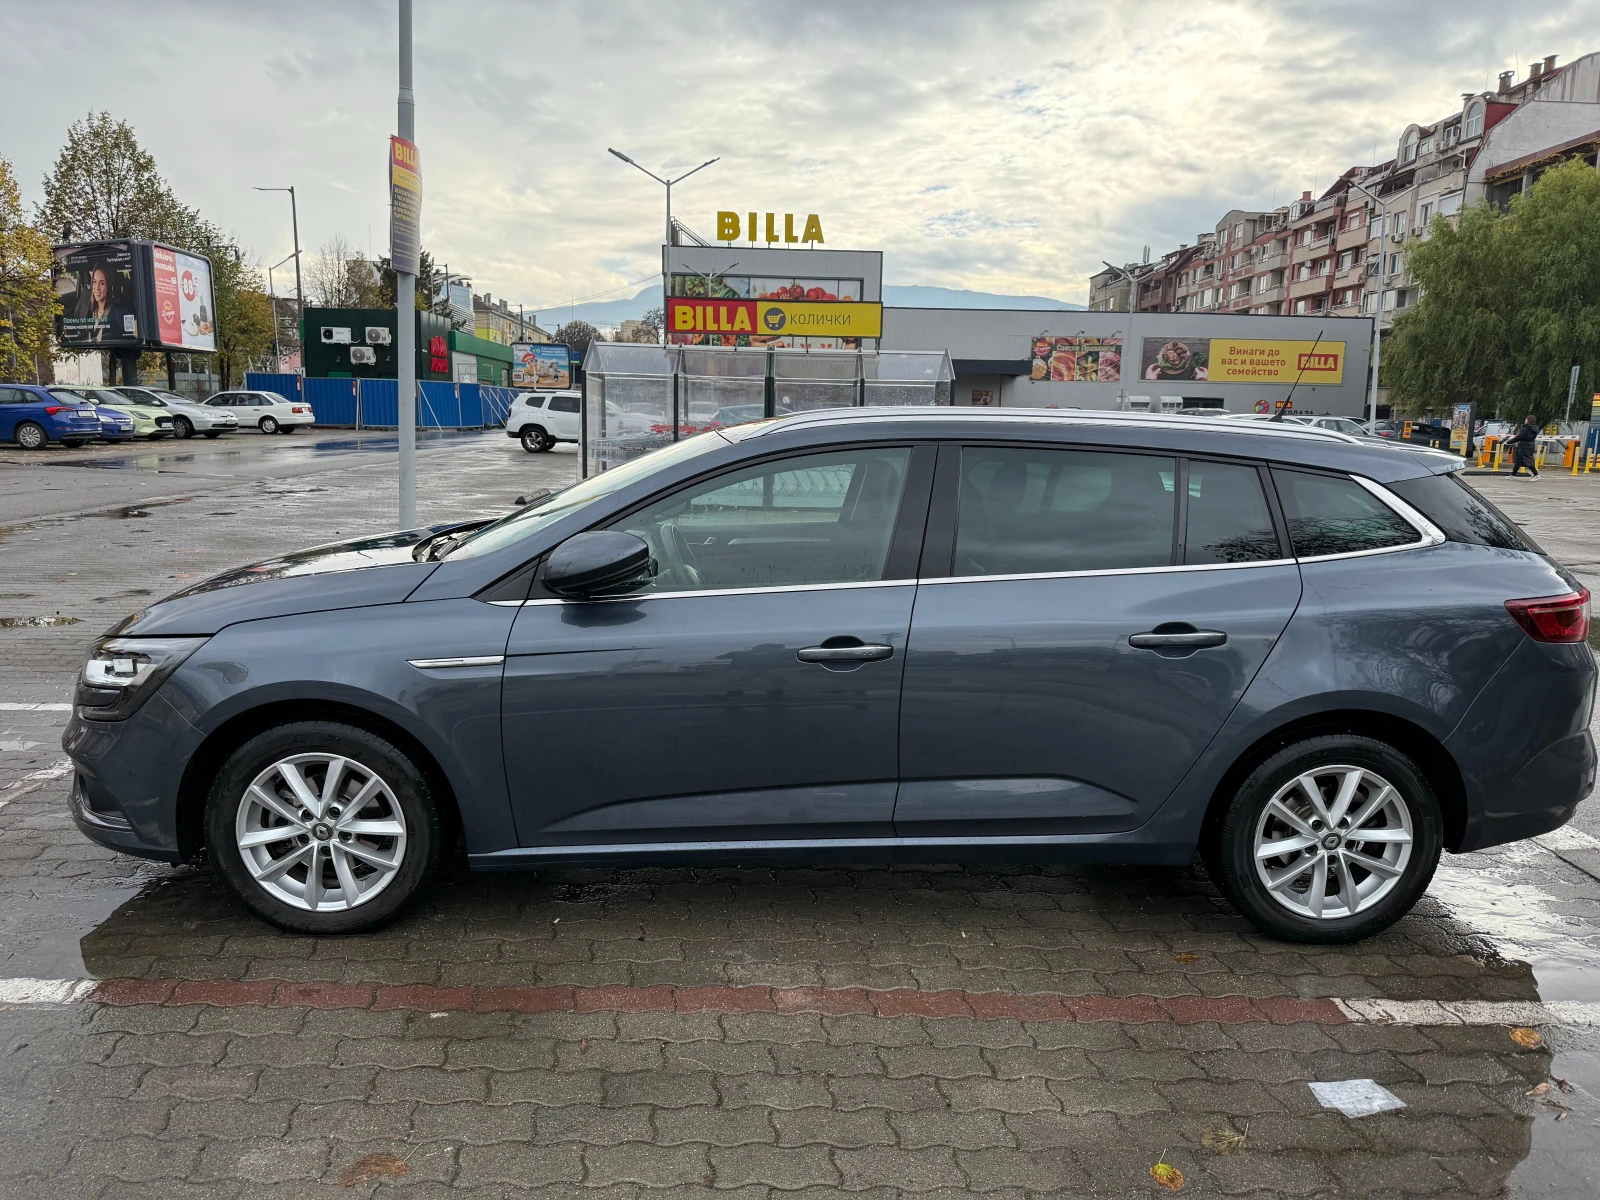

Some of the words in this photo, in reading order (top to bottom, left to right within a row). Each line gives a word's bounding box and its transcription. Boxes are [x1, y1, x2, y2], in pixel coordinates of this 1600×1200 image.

[717, 211, 825, 244] BILLA
[674, 305, 752, 331] BILLA
[790, 313, 851, 326] КОЛИЧКИ
[1229, 346, 1265, 356] Винаги
[1267, 348, 1280, 357] до
[1221, 357, 1238, 365] вас
[1240, 358, 1247, 366] и
[1249, 358, 1286, 366] вашето
[1300, 356, 1335, 369] BILLA
[1226, 367, 1279, 376] семейство
